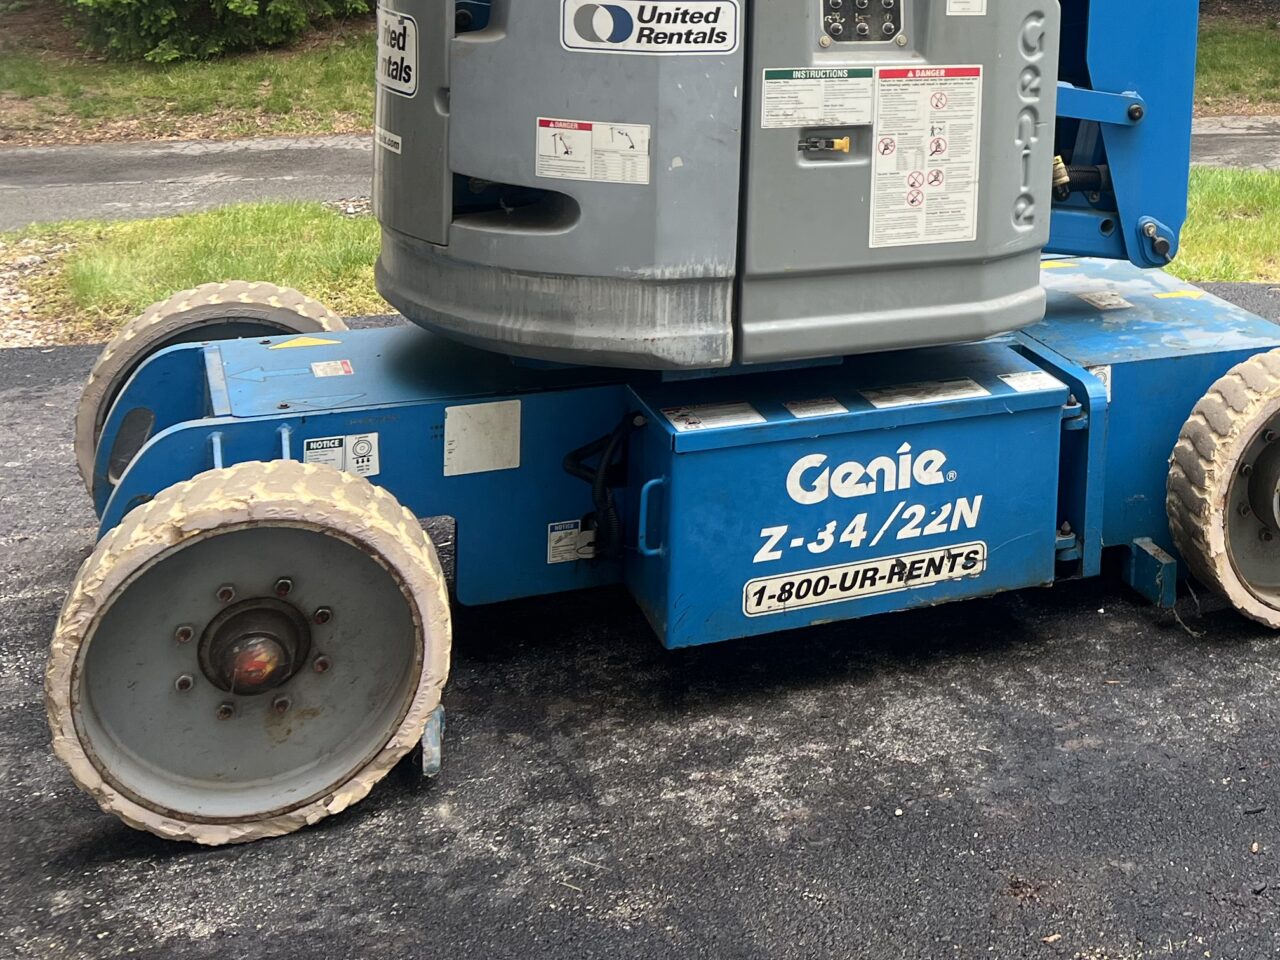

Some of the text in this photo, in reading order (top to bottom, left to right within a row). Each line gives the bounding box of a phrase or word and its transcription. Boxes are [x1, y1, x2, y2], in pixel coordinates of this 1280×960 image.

[637, 5, 722, 24] United
[382, 19, 407, 51] ited
[636, 27, 728, 44] Rentals
[380, 55, 413, 84] ntals
[792, 69, 848, 79] INSTRUCTIONS
[915, 69, 946, 78] DANGER
[554, 121, 579, 130] DANGER
[310, 439, 340, 449] NOTICE
[786, 441, 947, 505] Genie
[752, 495, 983, 564] Z-34/22N
[752, 549, 980, 608] 1-800-UR-RENTS
